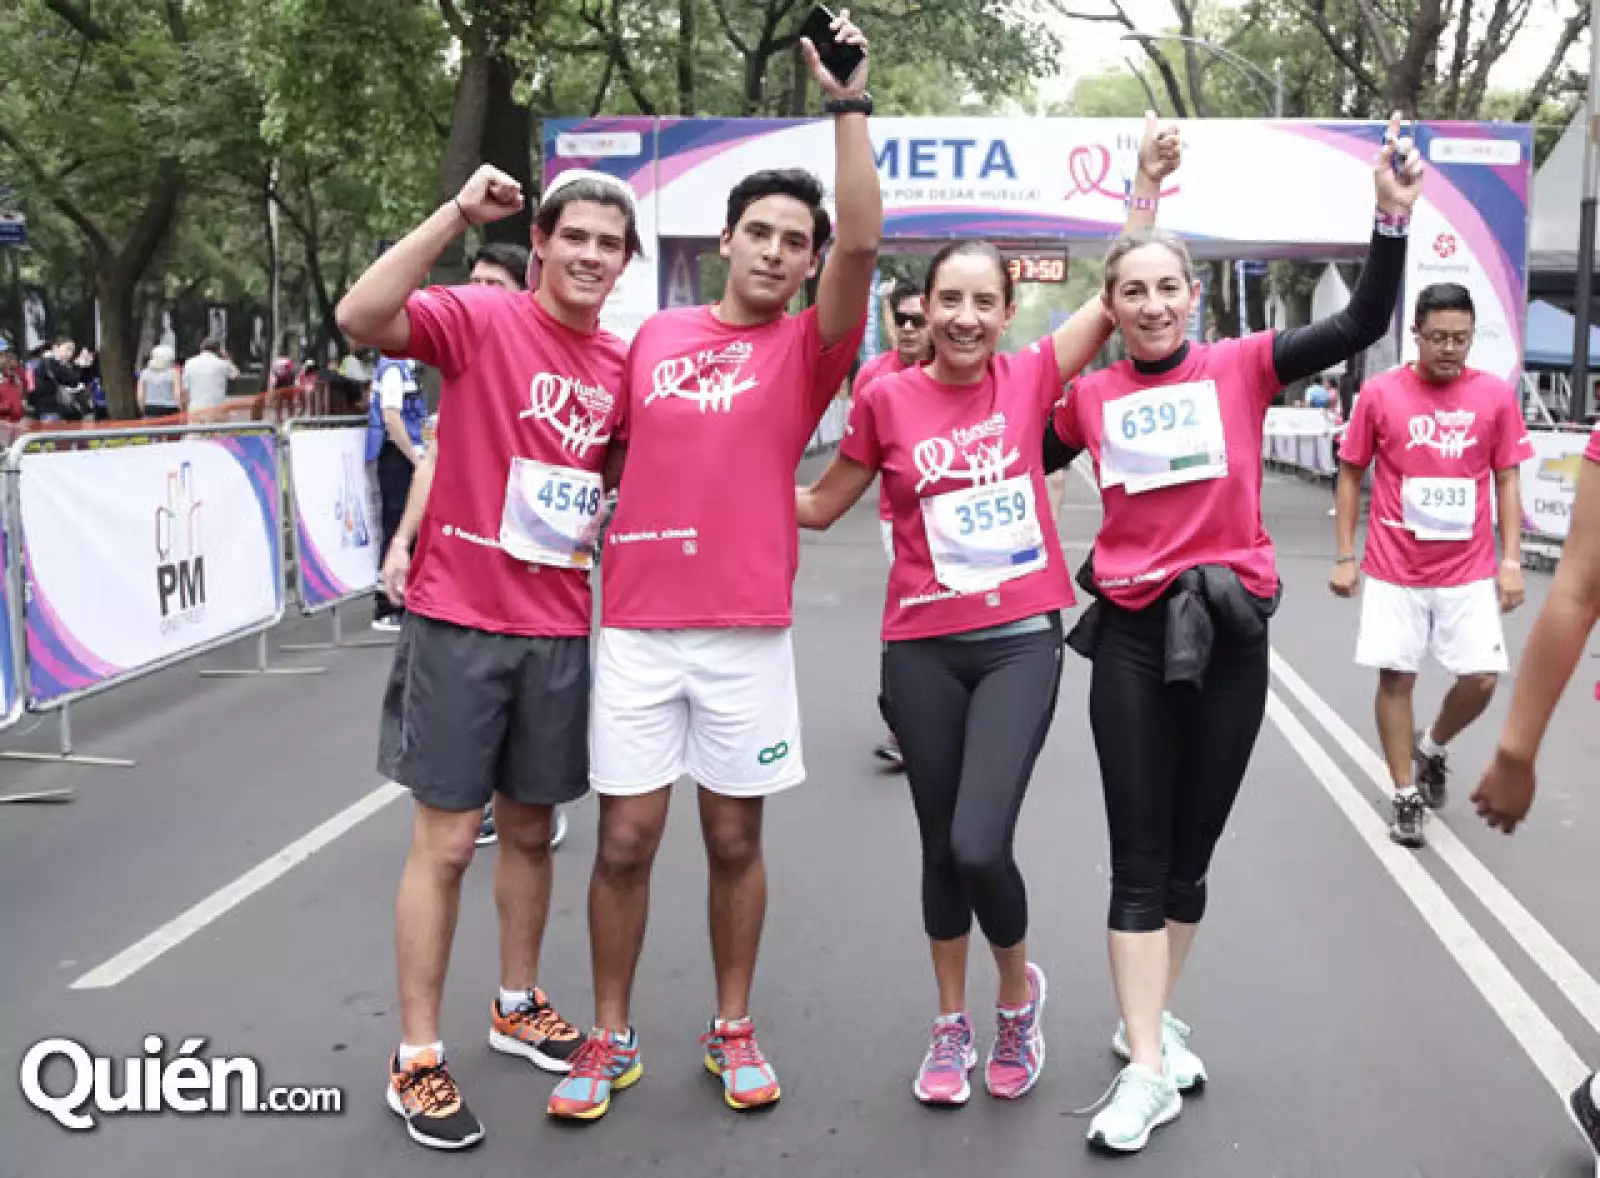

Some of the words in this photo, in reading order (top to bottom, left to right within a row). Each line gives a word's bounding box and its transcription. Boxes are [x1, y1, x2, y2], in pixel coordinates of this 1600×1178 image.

[1121, 397, 1201, 441] 6392
[537, 479, 600, 516] 4548
[955, 490, 1026, 536] 3559
[1420, 487, 1467, 507] 2933
[157, 555, 206, 617] PM
